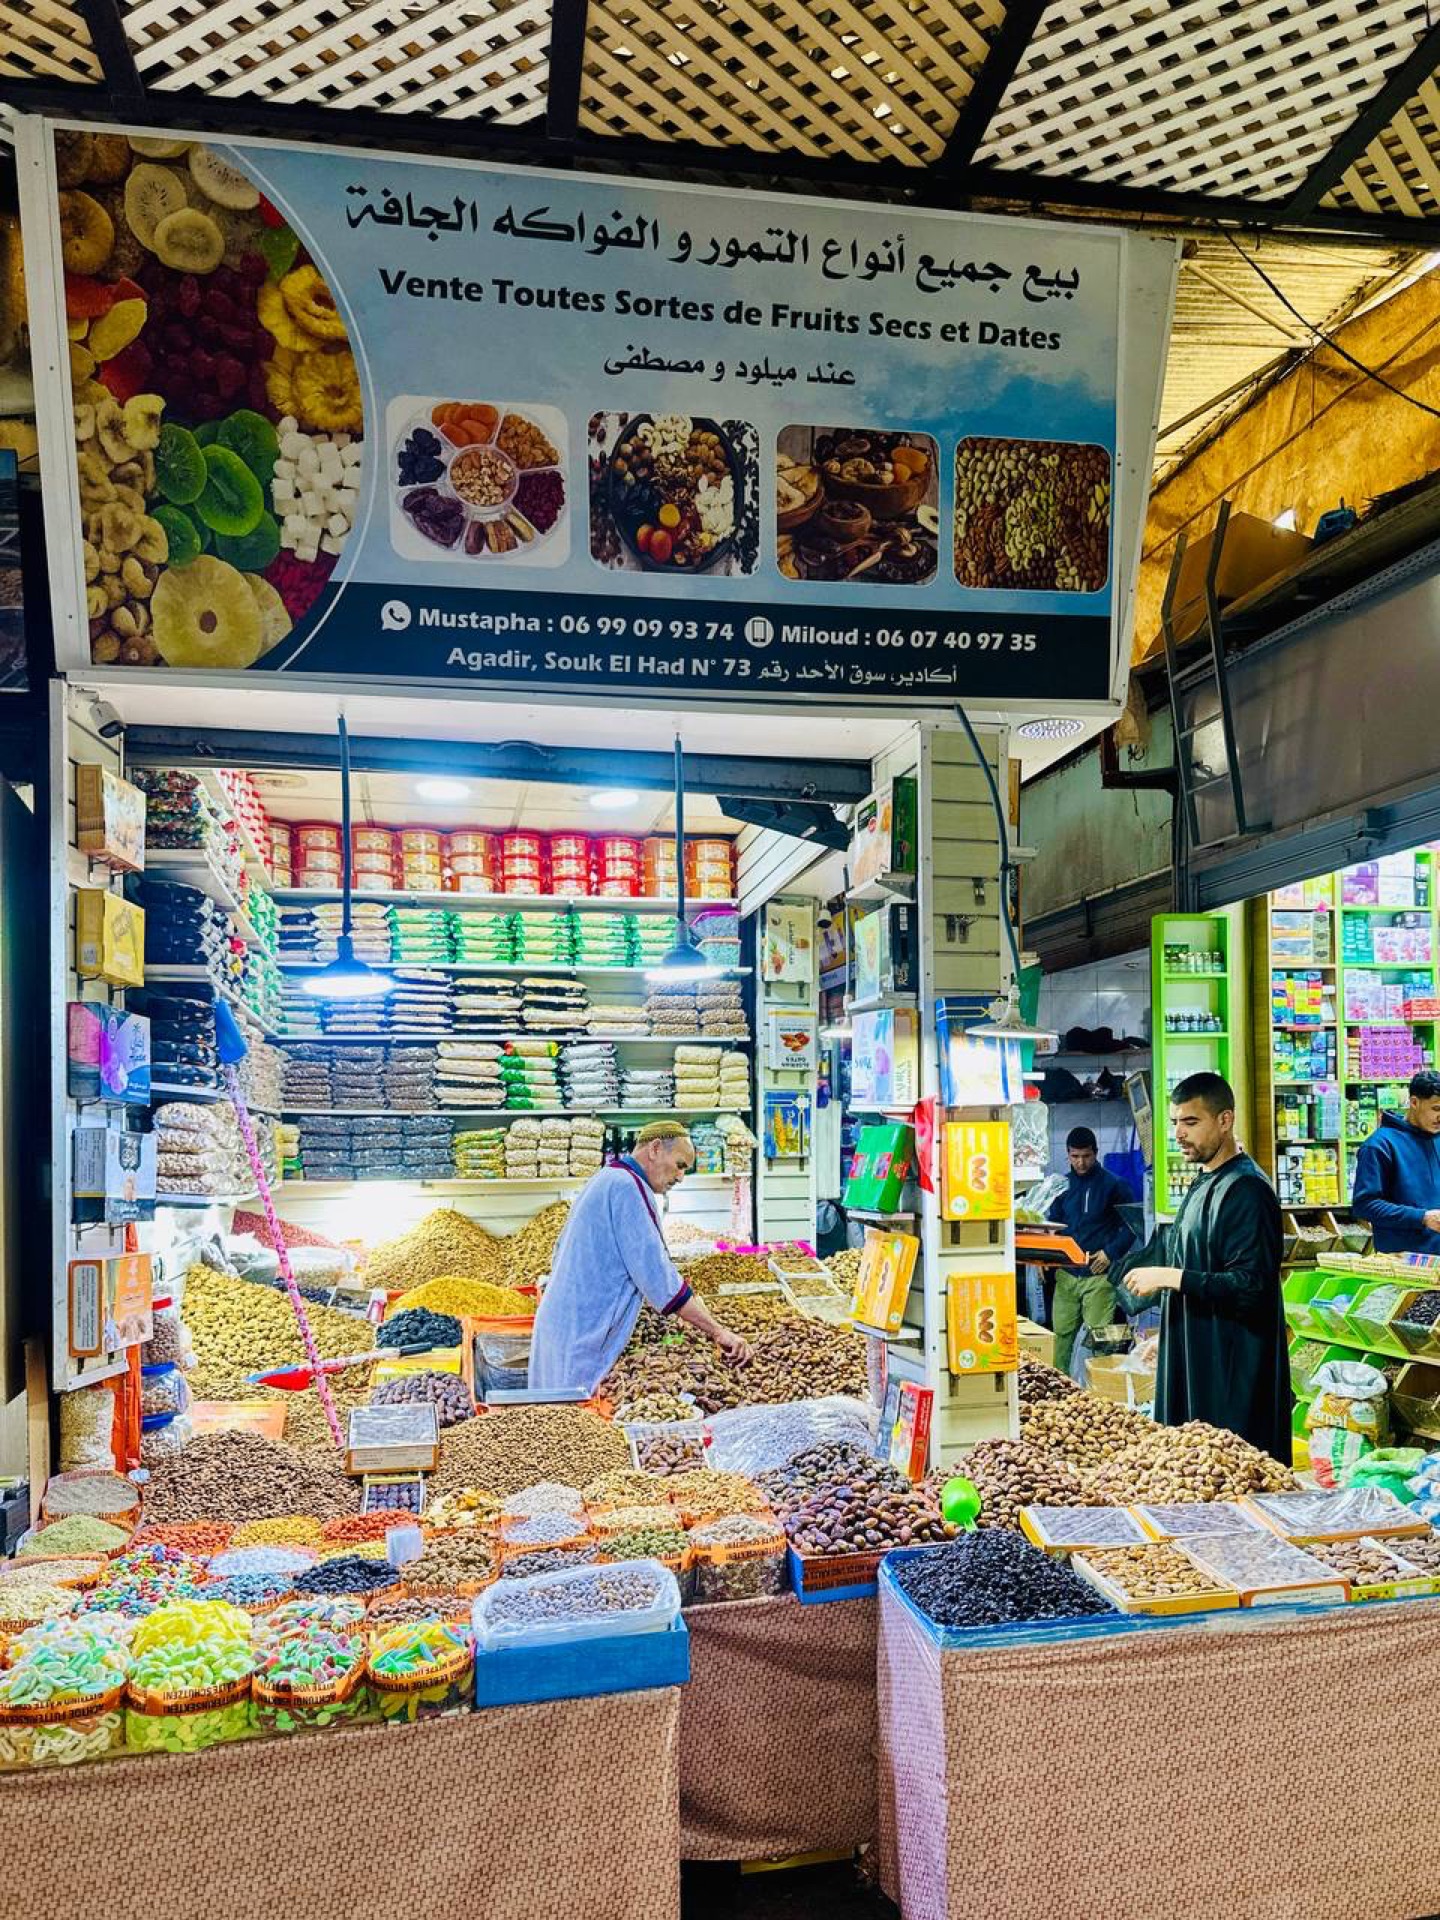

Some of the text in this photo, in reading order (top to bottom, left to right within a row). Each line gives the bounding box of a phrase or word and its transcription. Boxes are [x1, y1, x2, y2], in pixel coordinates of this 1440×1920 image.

[345, 185, 478, 242] الجافة
[492, 204, 660, 256] الفواكه
[696, 227, 809, 268] التمور
[821, 233, 906, 281] أنواع
[915, 254, 1012, 294] جميع
[1022, 264, 1080, 303] بيع
[378, 268, 1061, 351] Vente Toutes Sortes de Fruits Secs et Dates
[603, 344, 856, 387] عند ميلود و مصطفى
[419, 608, 540, 635] Mustapha
[560, 615, 590, 634] 06
[596, 617, 626, 635] 99
[633, 619, 663, 637] 09
[669, 620, 698, 639] 93
[705, 623, 734, 640] 74
[782, 625, 859, 645] Miloud
[876, 629, 904, 647] 06
[910, 630, 937, 648] 07
[944, 632, 971, 649] 40
[977, 632, 1004, 650] 97
[1010, 634, 1036, 651] 35
[446, 647, 537, 671] Agadir,
[545, 652, 602, 671] Souk
[610, 655, 631, 673] El
[638, 656, 685, 675] Had
[723, 658, 751, 676] 73
[756, 659, 790, 683] رقم
[795, 659, 844, 681] الأحد
[849, 663, 886, 685] سوق
